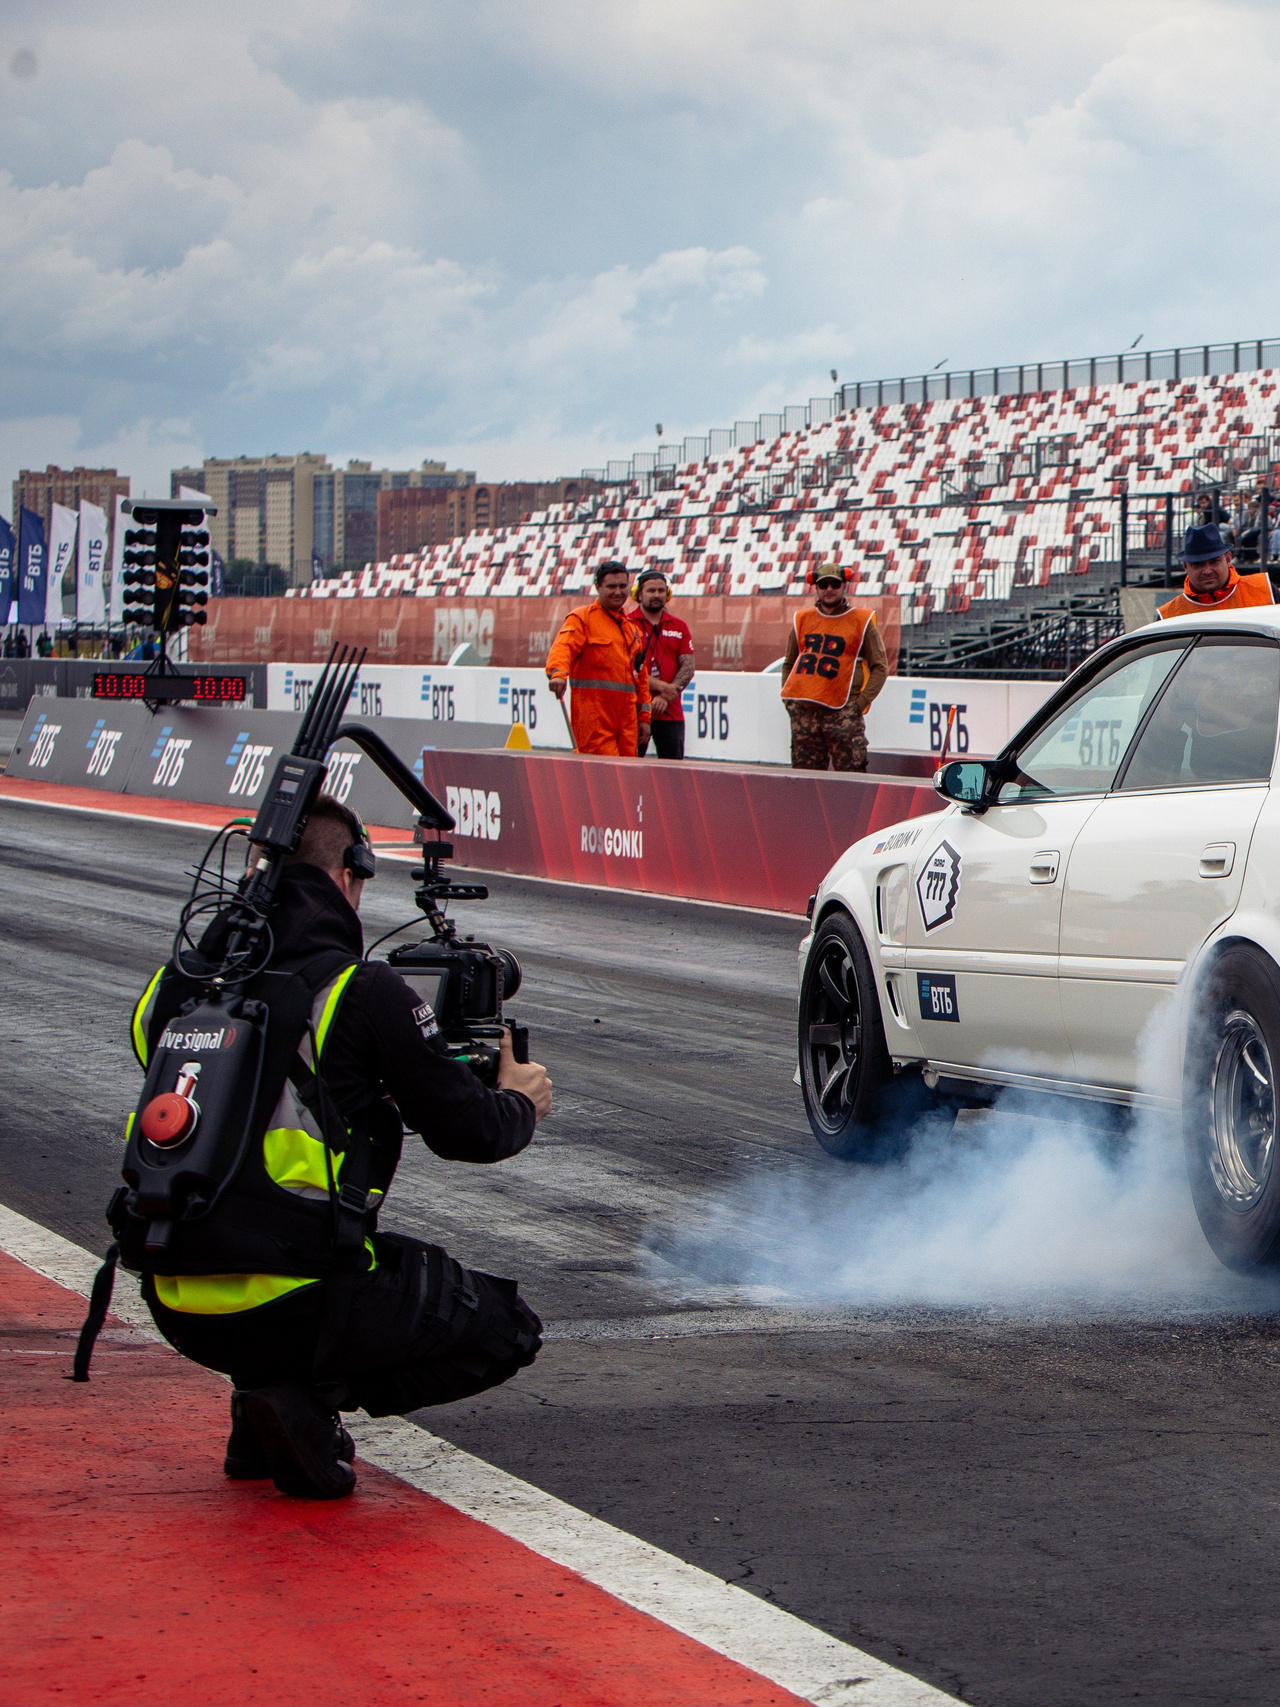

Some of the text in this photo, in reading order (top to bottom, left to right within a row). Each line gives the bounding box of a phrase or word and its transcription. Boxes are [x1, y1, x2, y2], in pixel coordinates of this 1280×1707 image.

[28, 544, 43, 577] ВТБ
[88, 539, 103, 572] ВТБ
[433, 607, 495, 662] RDRC
[798, 633, 846, 658] RD
[795, 653, 840, 680] RC
[94, 674, 145, 698] 10.00
[193, 676, 244, 700] 10.00
[361, 683, 382, 716] ВТБ
[432, 685, 455, 721] ВТБ
[511, 688, 538, 730] ВТБ
[698, 694, 729, 741] ВТБ
[29, 724, 62, 768] ВТБ
[86, 730, 123, 777] ВТБ
[1079, 719, 1123, 766] ВТБ
[152, 738, 193, 787] ВТБ
[228, 745, 274, 796] ВТБ
[446, 785, 501, 841] RDRC
[581, 825, 643, 859] ROSGONKI
[926, 871, 947, 902] 777
[931, 986, 953, 1014] ВТБ
[158, 1027, 225, 1053] live signal
